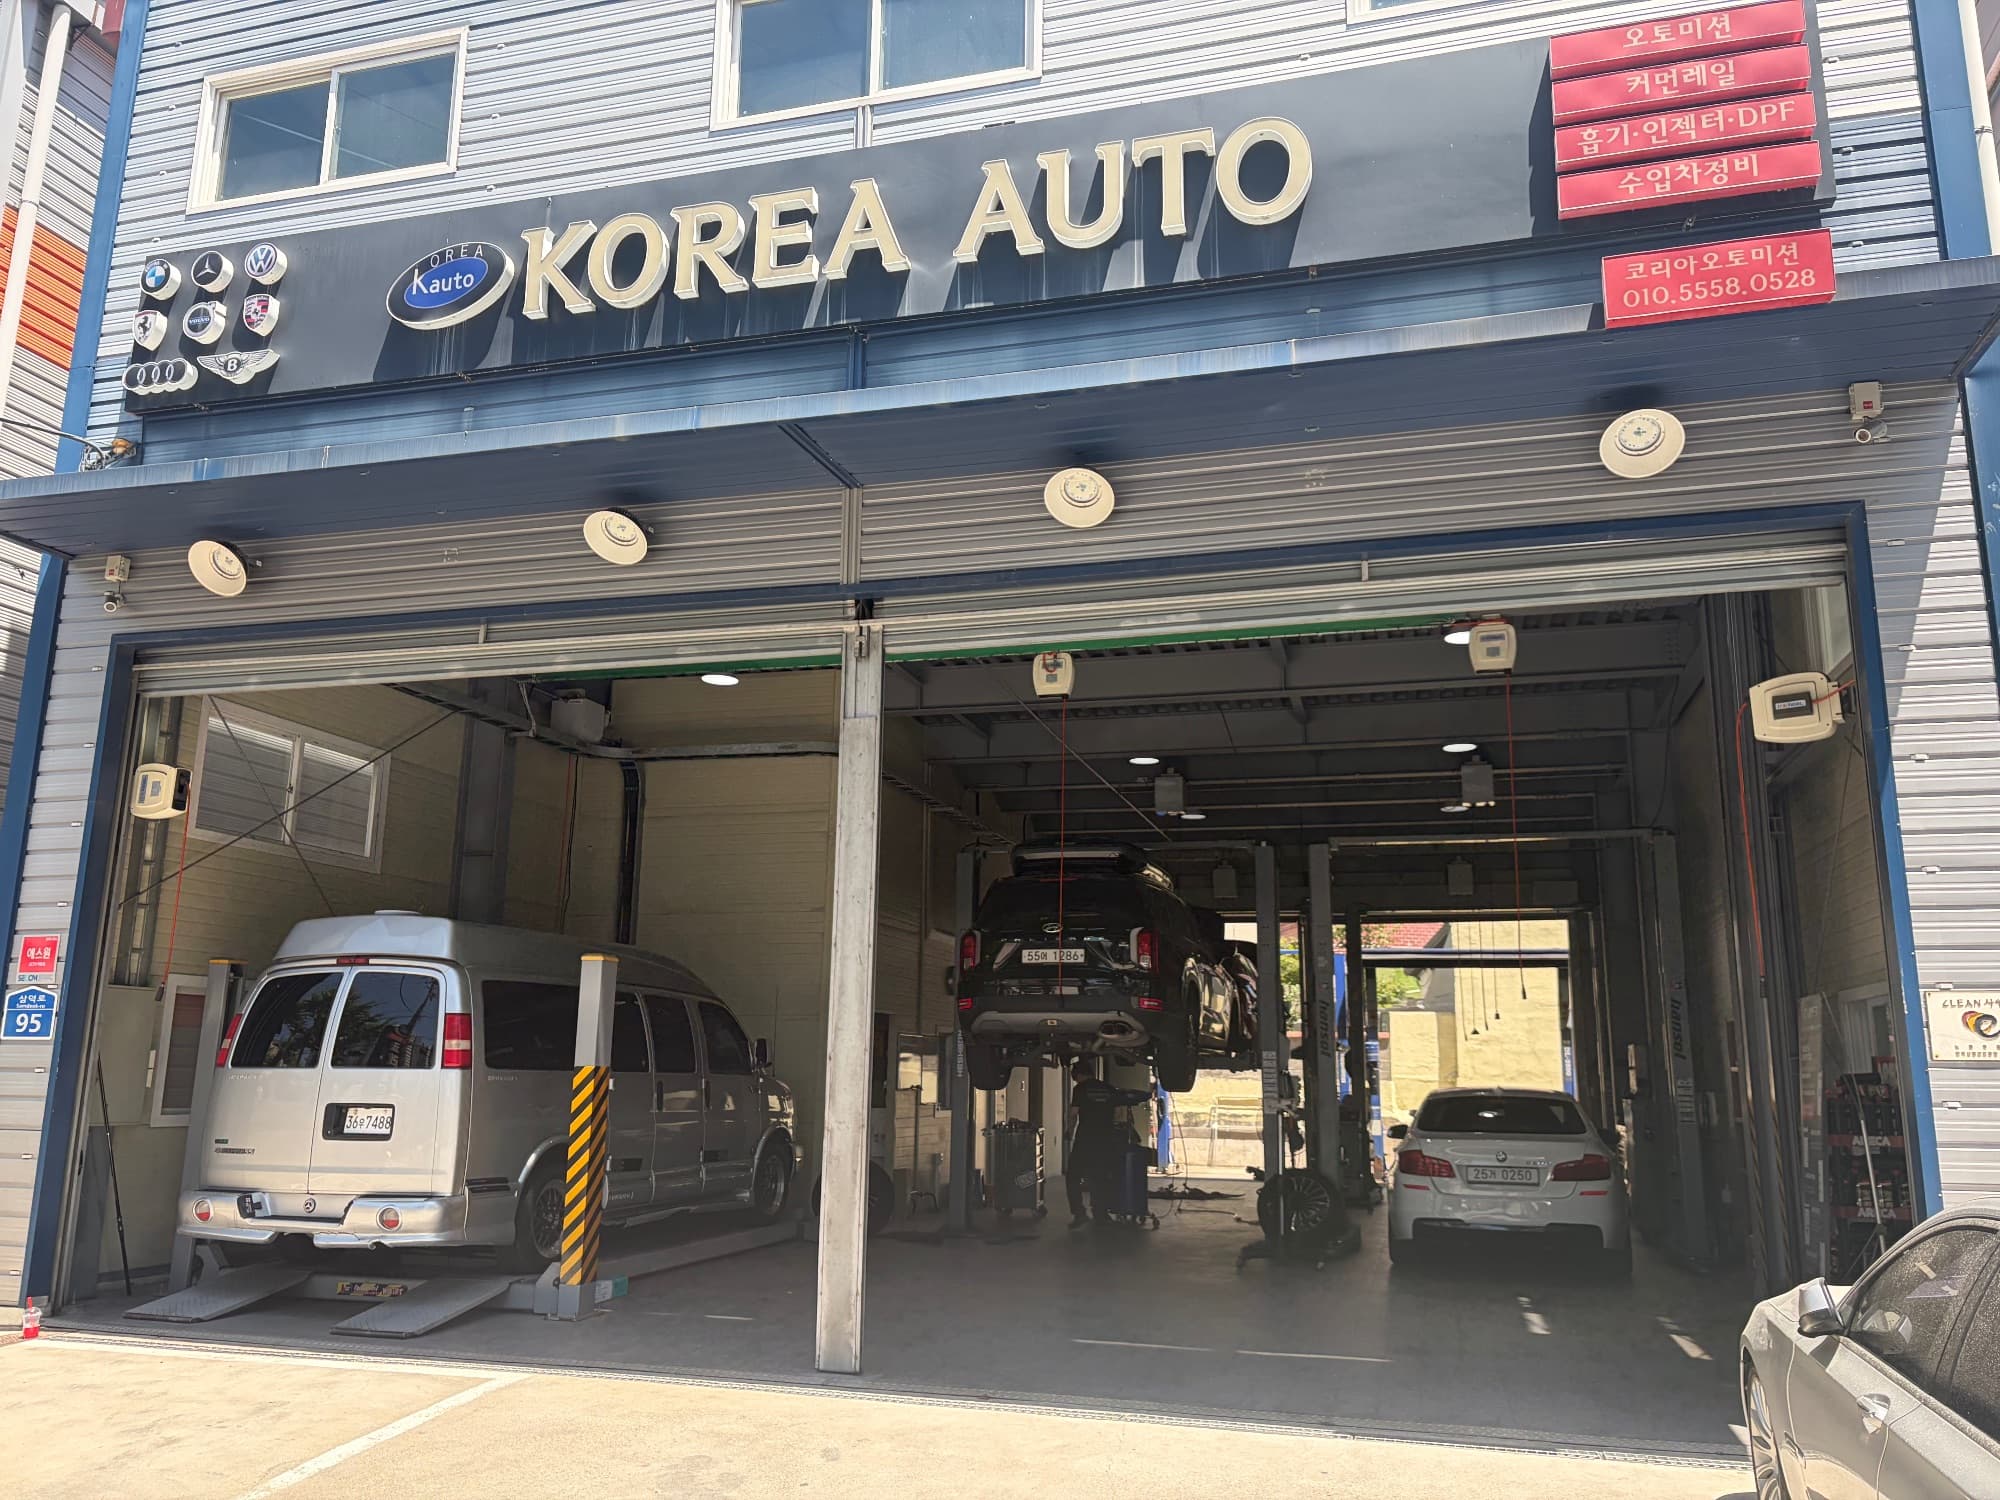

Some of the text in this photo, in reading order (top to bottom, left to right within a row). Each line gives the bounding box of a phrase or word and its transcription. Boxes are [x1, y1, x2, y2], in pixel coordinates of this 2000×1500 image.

[1623, 14, 1732, 48] 오토미션
[1626, 60, 1736, 95] 커먼레일
[1618, 154, 1759, 194] 수입차정비
[521, 117, 1313, 320] KOREA AUTO
[1625, 242, 1800, 280] 코리아오토미션
[412, 268, 475, 295] Kauto
[1623, 268, 1816, 308] 010.5558.0528
[15, 1013, 42, 1032] 95
[1501, 1169, 1532, 1181] 0250
